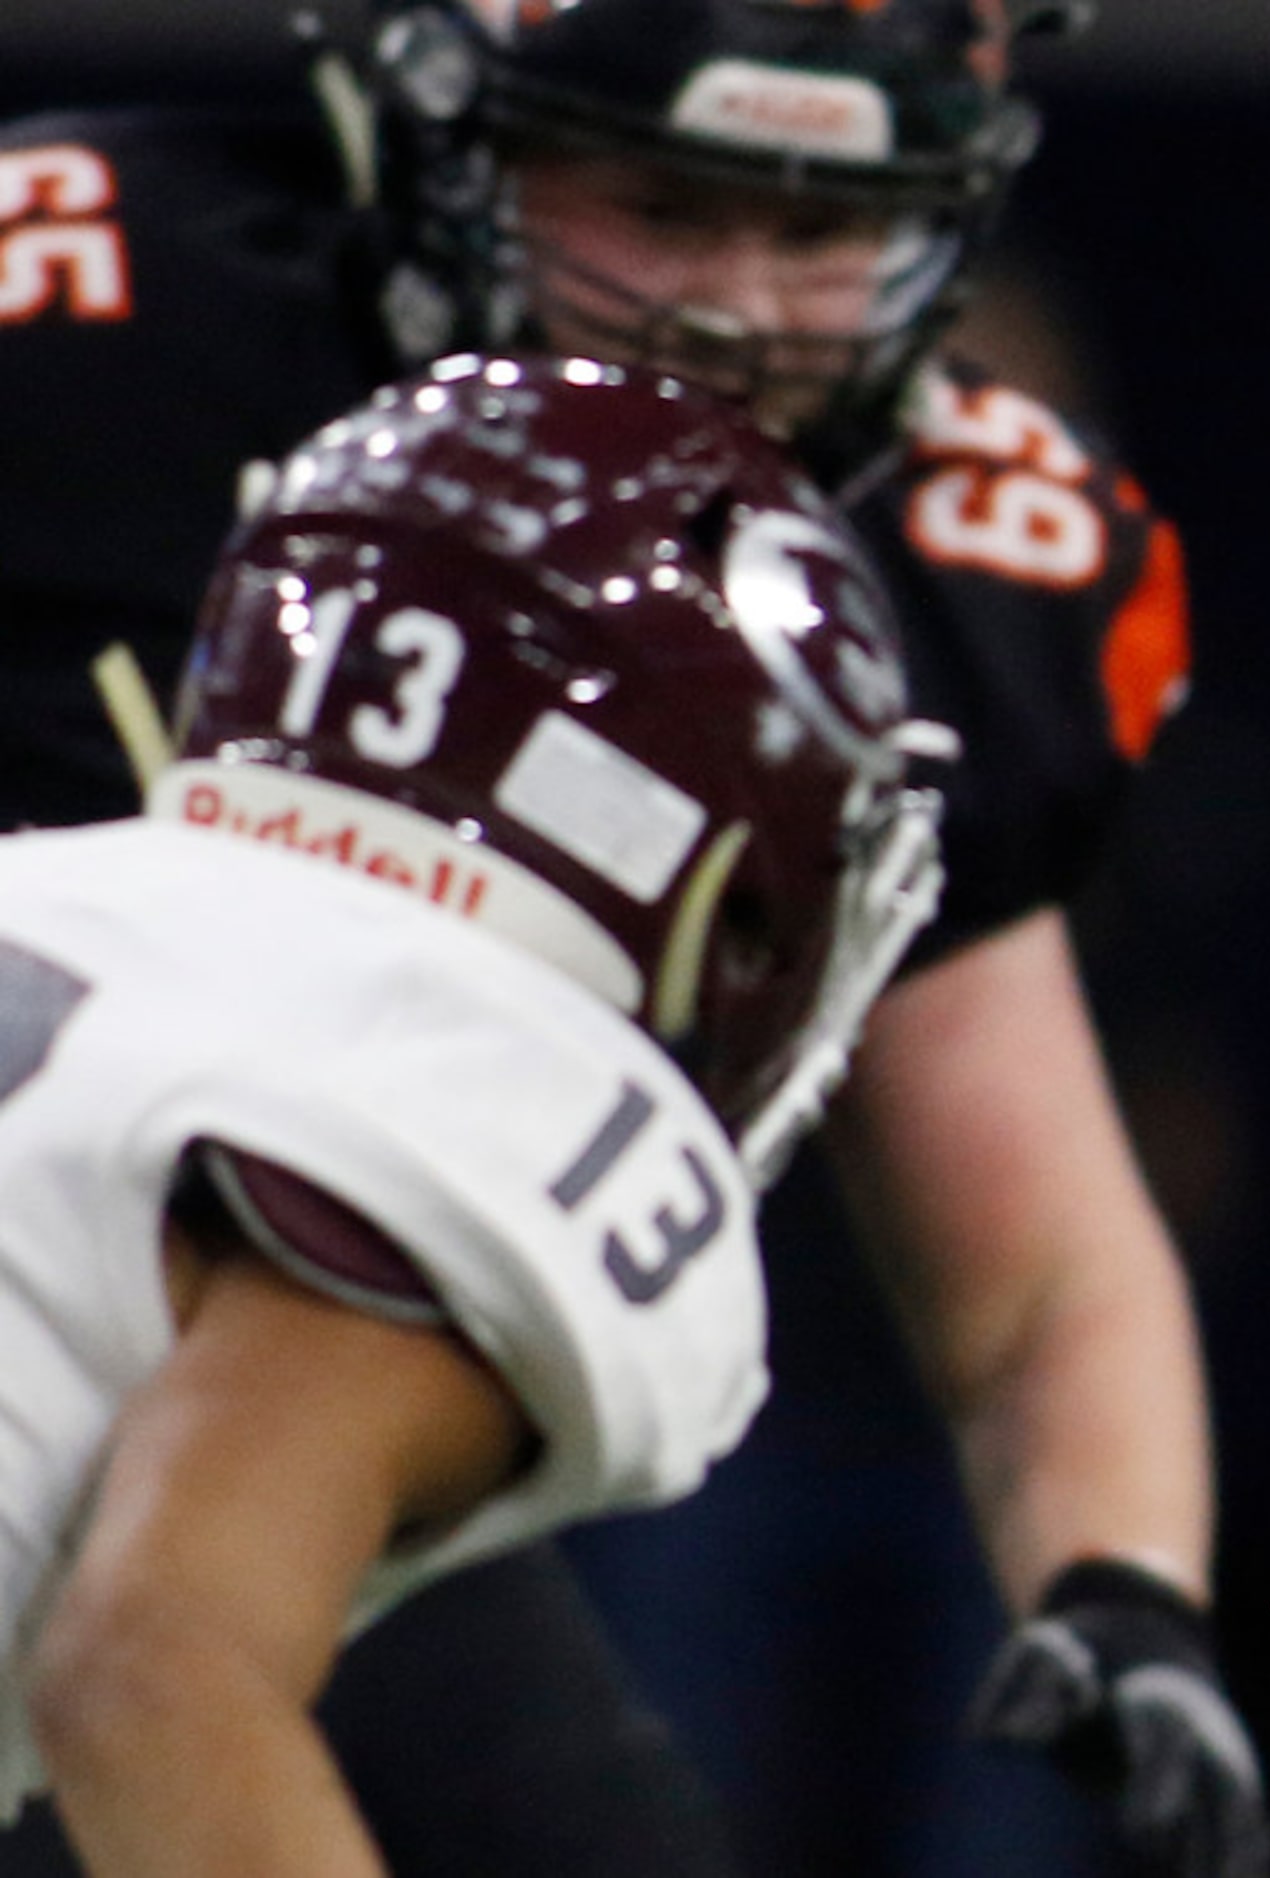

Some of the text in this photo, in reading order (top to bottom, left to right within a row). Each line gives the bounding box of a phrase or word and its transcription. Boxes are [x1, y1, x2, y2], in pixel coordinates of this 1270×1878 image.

[902, 358, 1108, 588] 65
[280, 583, 467, 768] 13
[546, 1078, 726, 1305] 13
